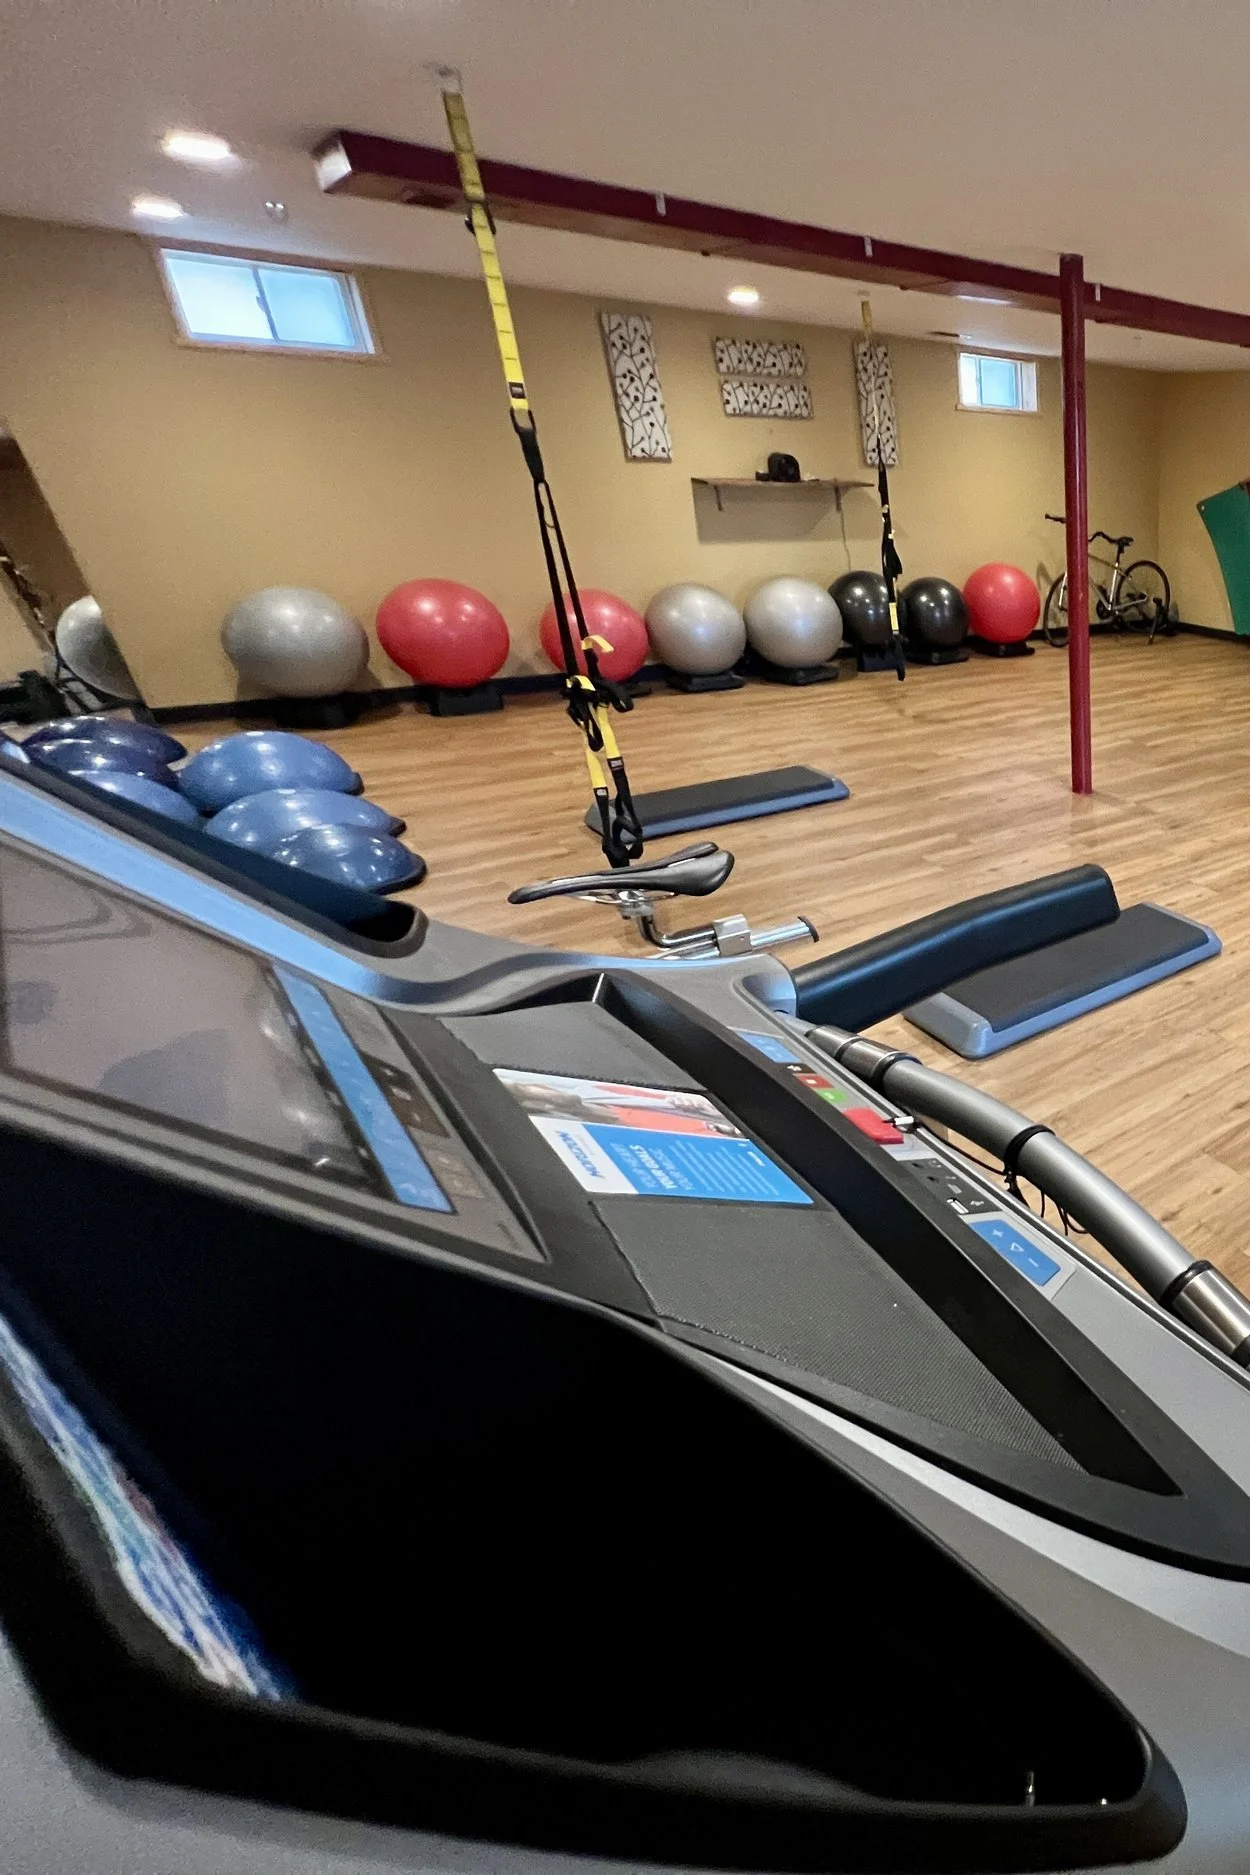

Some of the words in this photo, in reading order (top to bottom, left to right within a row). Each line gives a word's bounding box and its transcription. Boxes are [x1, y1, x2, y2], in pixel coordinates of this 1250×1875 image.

[556, 1131, 604, 1178] HORIZON
[628, 1144, 659, 1169] GOALS
[651, 1168, 678, 1189] YOUR
